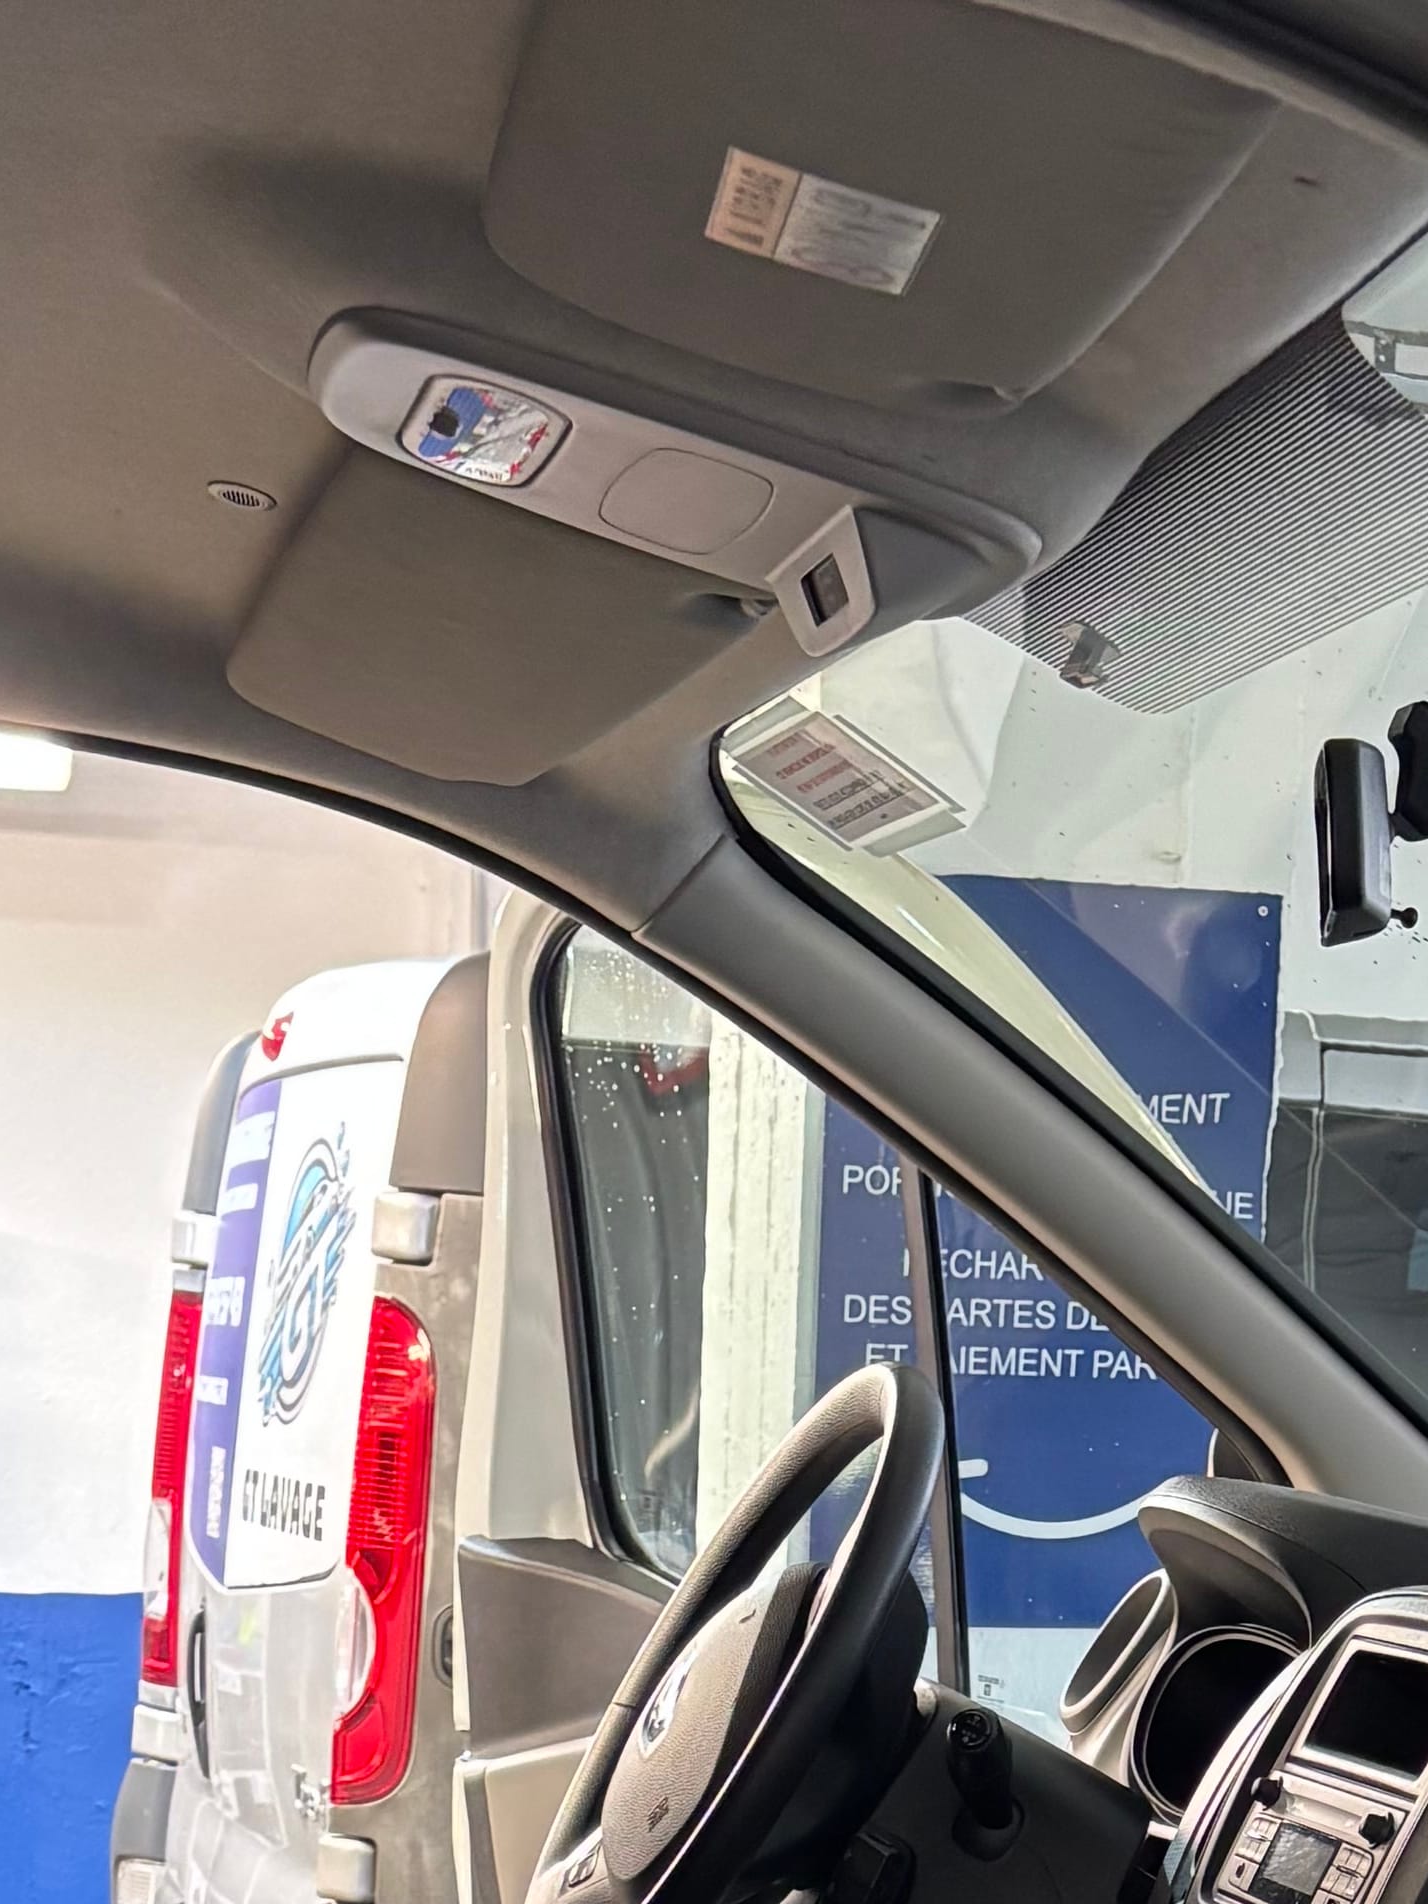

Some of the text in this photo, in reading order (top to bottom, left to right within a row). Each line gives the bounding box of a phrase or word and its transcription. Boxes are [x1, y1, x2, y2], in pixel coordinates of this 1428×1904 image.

[843, 1293, 913, 1326] DES
[947, 1297, 1057, 1330] ARTES
[259, 1471, 326, 1542] LAVAGE
